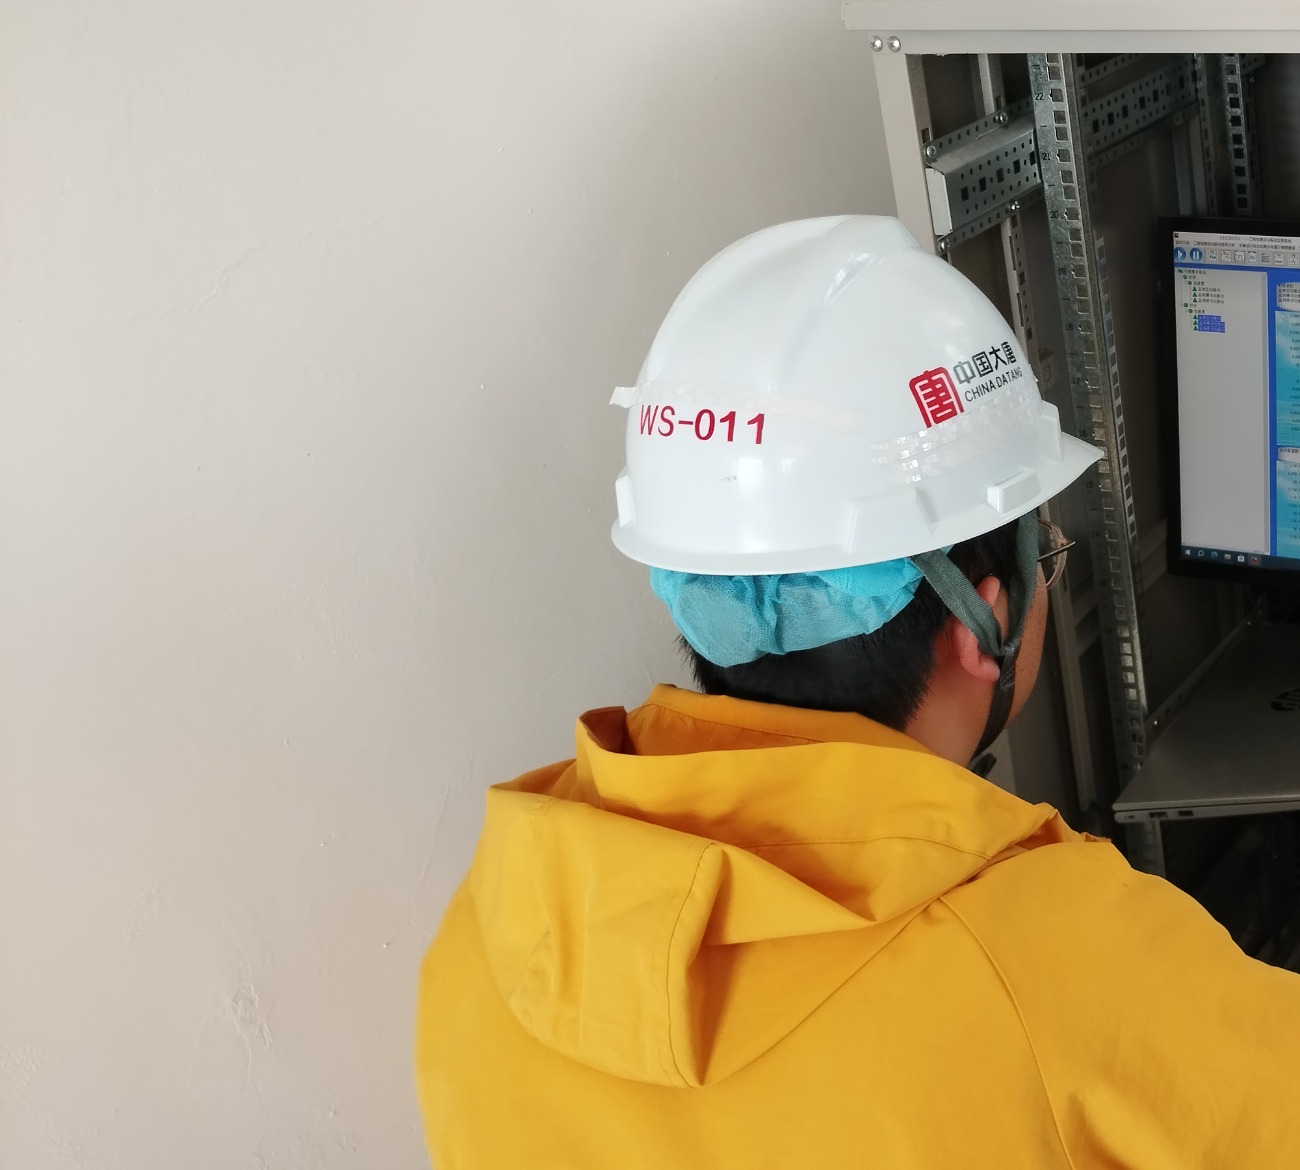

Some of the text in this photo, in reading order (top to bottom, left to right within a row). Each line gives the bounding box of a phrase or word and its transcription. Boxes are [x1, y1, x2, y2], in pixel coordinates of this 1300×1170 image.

[1034, 92, 1044, 101] 22
[953, 341, 1017, 385] 中国大唐
[964, 367, 1023, 402] CHINA DATANG
[640, 404, 765, 445] WS-011
